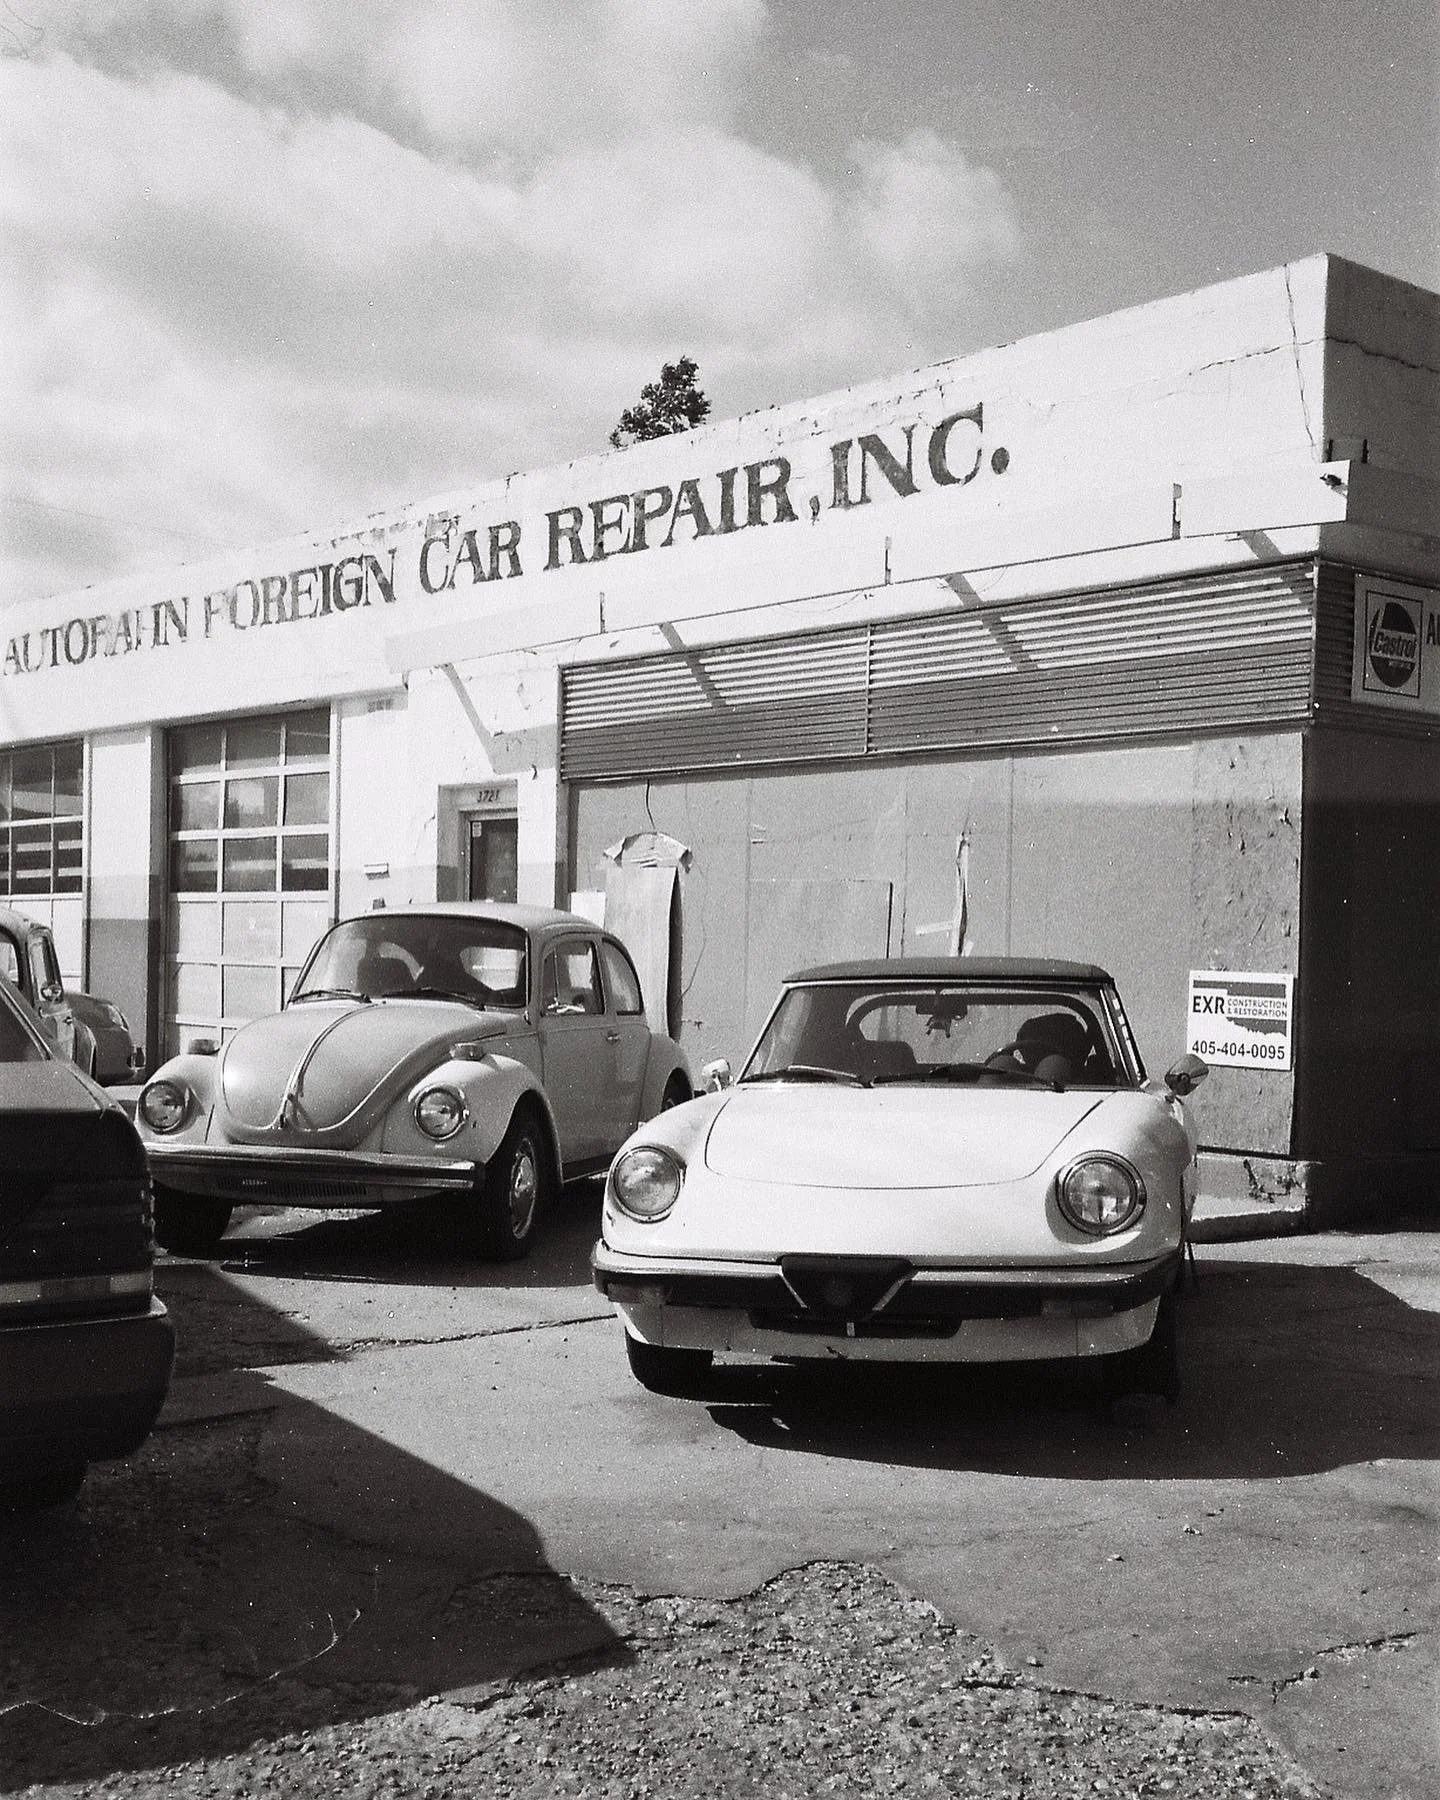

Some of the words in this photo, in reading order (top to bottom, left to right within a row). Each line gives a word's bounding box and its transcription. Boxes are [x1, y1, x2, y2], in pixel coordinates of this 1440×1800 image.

[203, 547, 397, 639] FOREIGN
[419, 520, 524, 595] CAR
[543, 456, 821, 572] REPAIR,
[827, 401, 1011, 509] INC.
[1374, 631, 1416, 659] Castrol
[1192, 995, 1225, 1015] EXR
[1227, 998, 1288, 1009] CONSTRUCTION
[1233, 1008, 1287, 1017] RESTORATION
[1192, 1040, 1285, 1060] 405-404-0095
